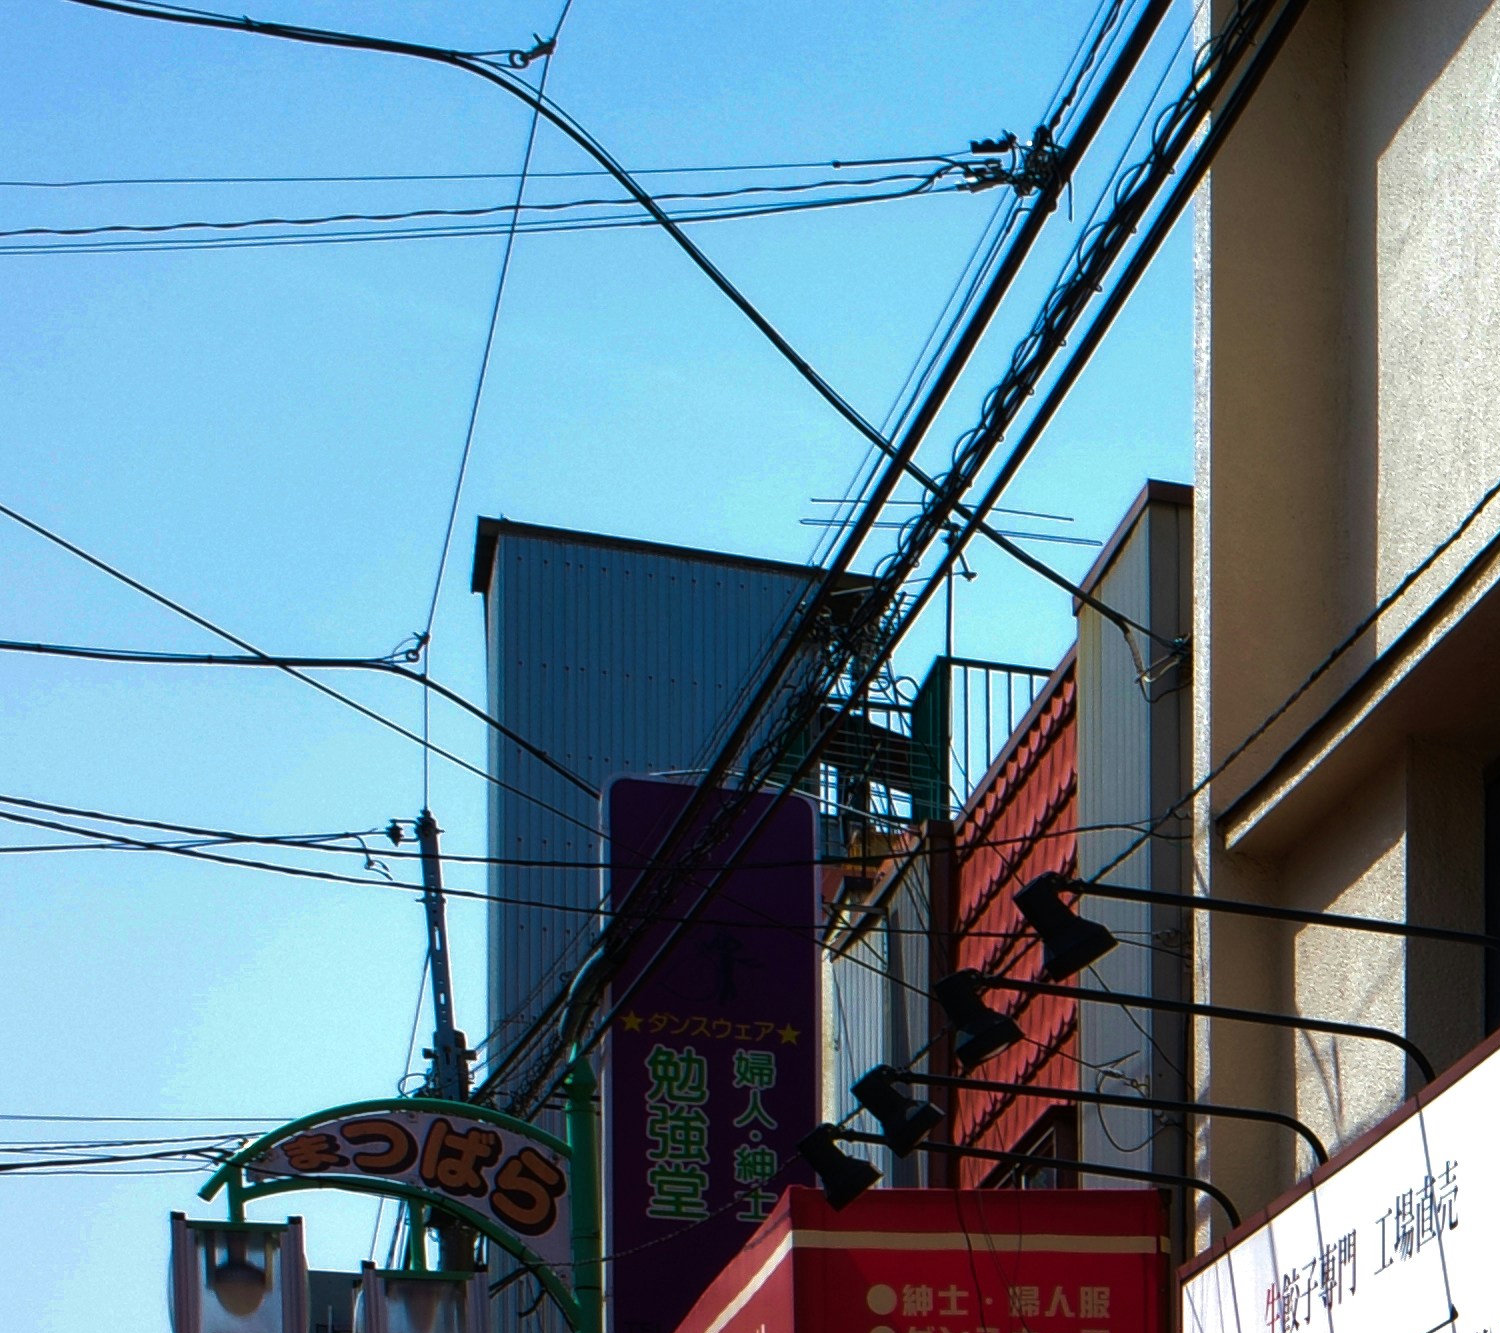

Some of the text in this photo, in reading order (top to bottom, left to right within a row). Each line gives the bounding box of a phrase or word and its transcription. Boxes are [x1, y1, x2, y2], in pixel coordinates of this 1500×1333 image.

[649, 1011, 776, 1042] ダンスウェア
[284, 1118, 567, 1236] まつばら
[645, 1044, 711, 1222] 勉強堂
[1374, 1160, 1459, 1276] 工場直売
